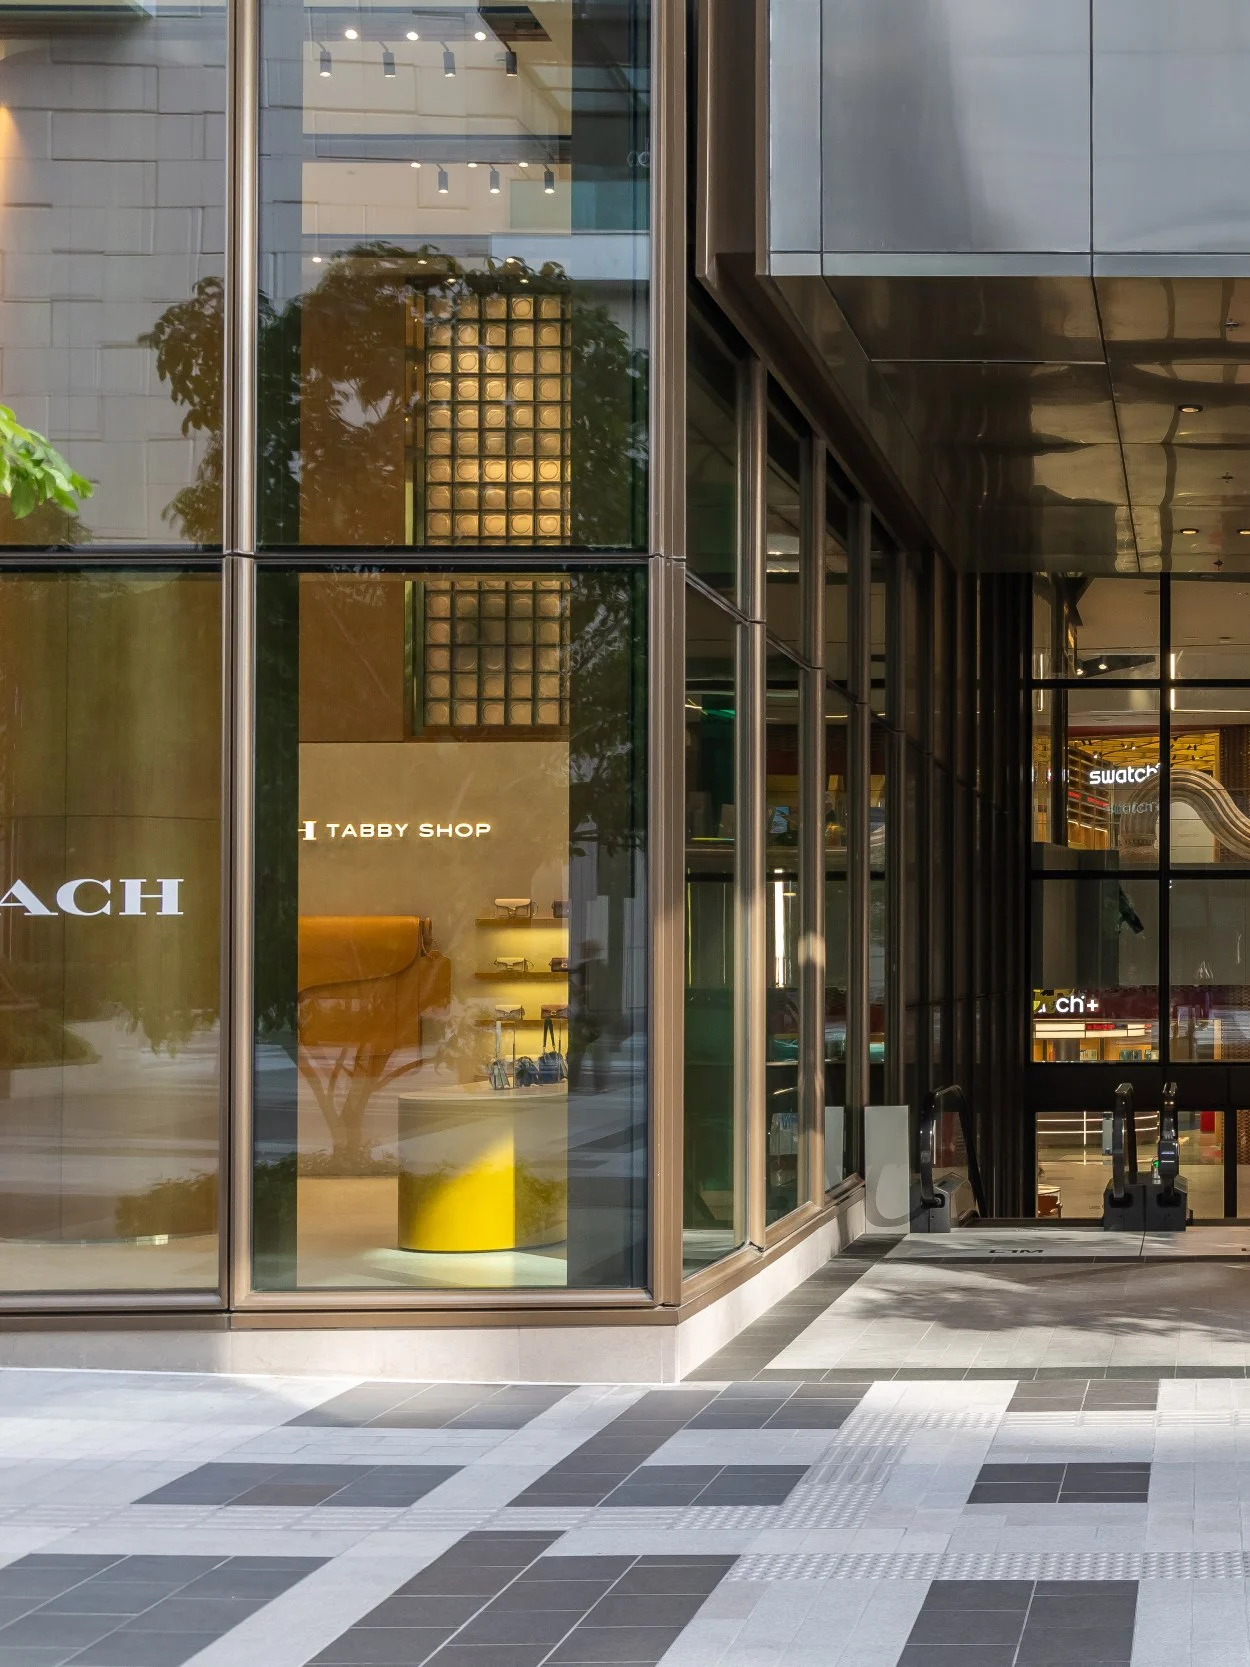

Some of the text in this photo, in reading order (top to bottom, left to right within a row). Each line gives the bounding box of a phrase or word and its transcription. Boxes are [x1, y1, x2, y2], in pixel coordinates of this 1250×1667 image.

[1089, 764, 1158, 785] swatch
[326, 823, 408, 838] TABBY
[418, 823, 491, 838] SHOP
